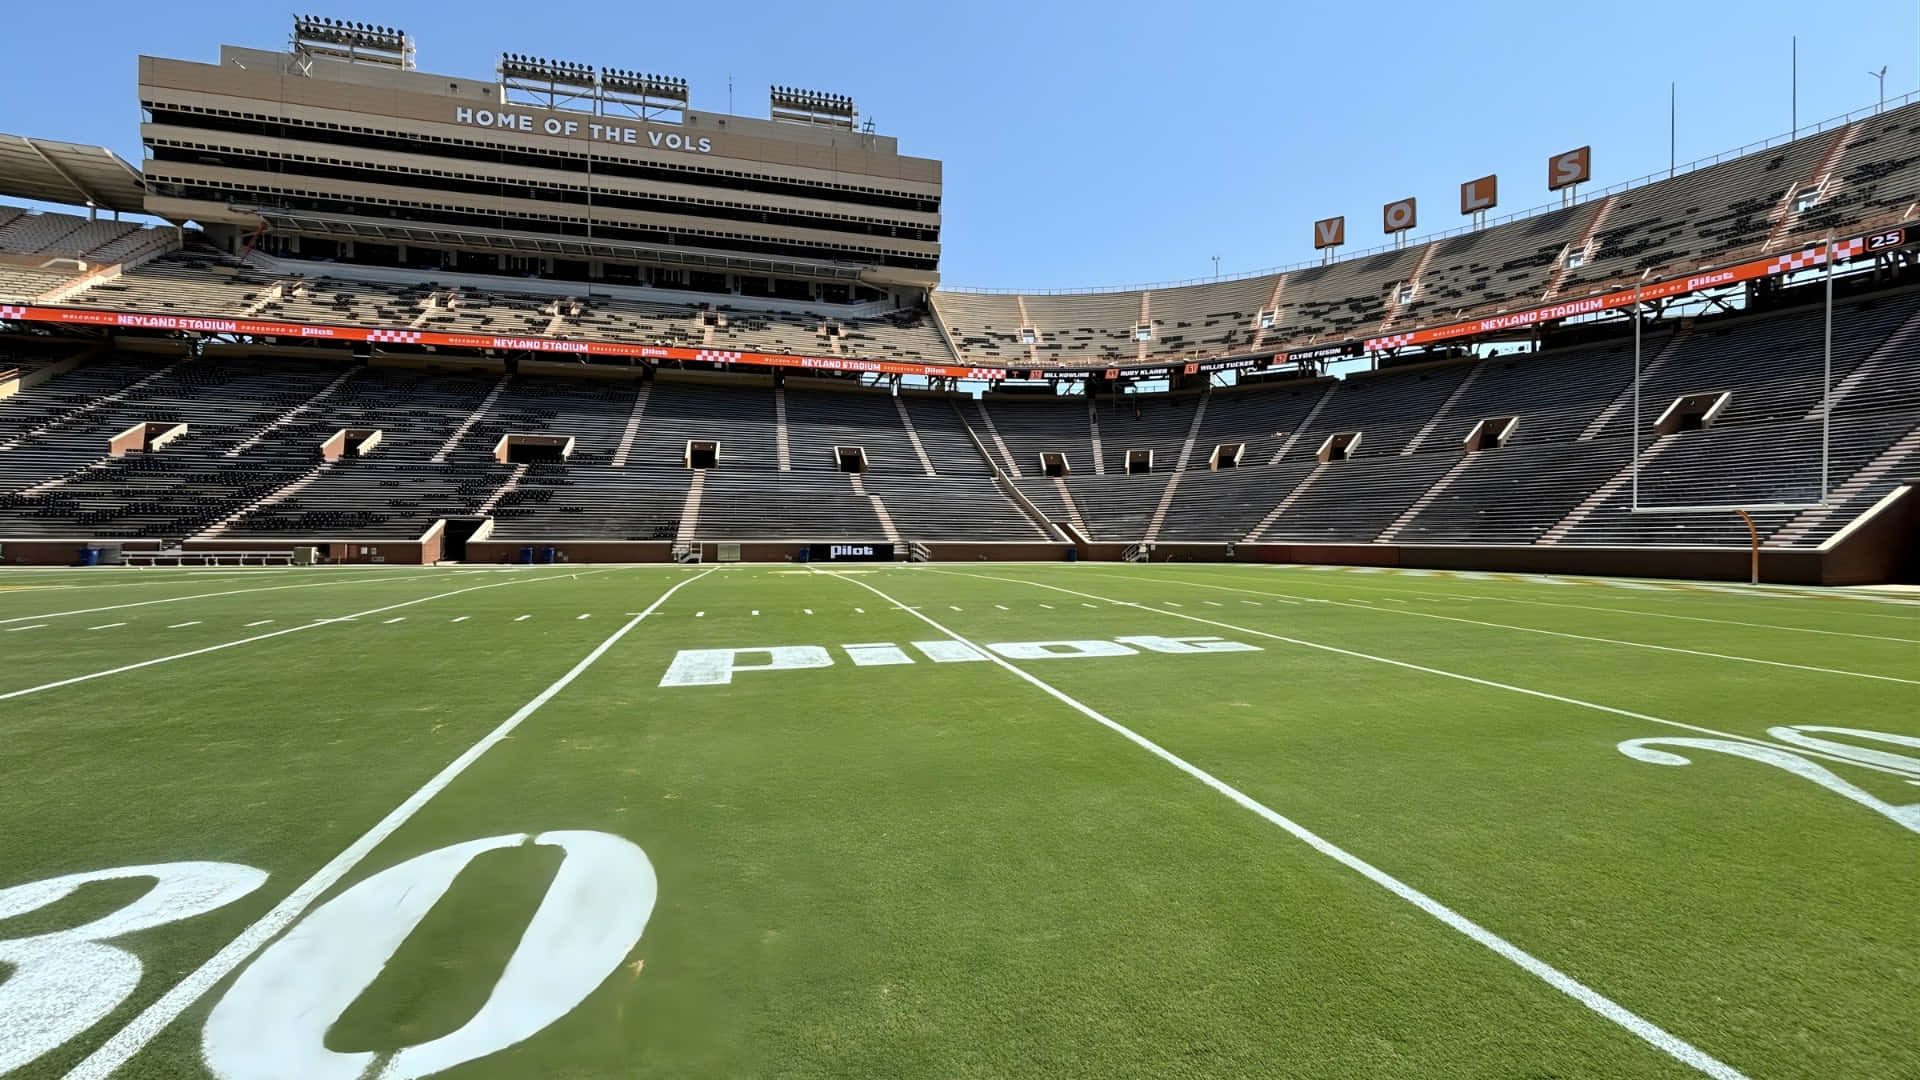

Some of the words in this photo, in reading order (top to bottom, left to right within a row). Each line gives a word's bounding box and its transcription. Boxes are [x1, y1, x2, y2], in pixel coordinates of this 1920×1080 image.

[456, 107, 533, 131] HOME
[544, 118, 578, 136] OF
[590, 124, 637, 144] THE
[648, 131, 712, 153] VOLS
[1871, 231, 1900, 248] 25
[117, 314, 177, 328] NEYLAND
[179, 318, 236, 331] STADIUM
[1480, 310, 1537, 331] NEYLAND
[1540, 298, 1603, 320] STADIUM
[493, 338, 541, 350] NEYLAND
[542, 341, 588, 352] STADIUM
[801, 357, 841, 369] NEYLAND
[842, 360, 881, 371] STADIUM
[1225, 360, 1254, 369] TUCKER
